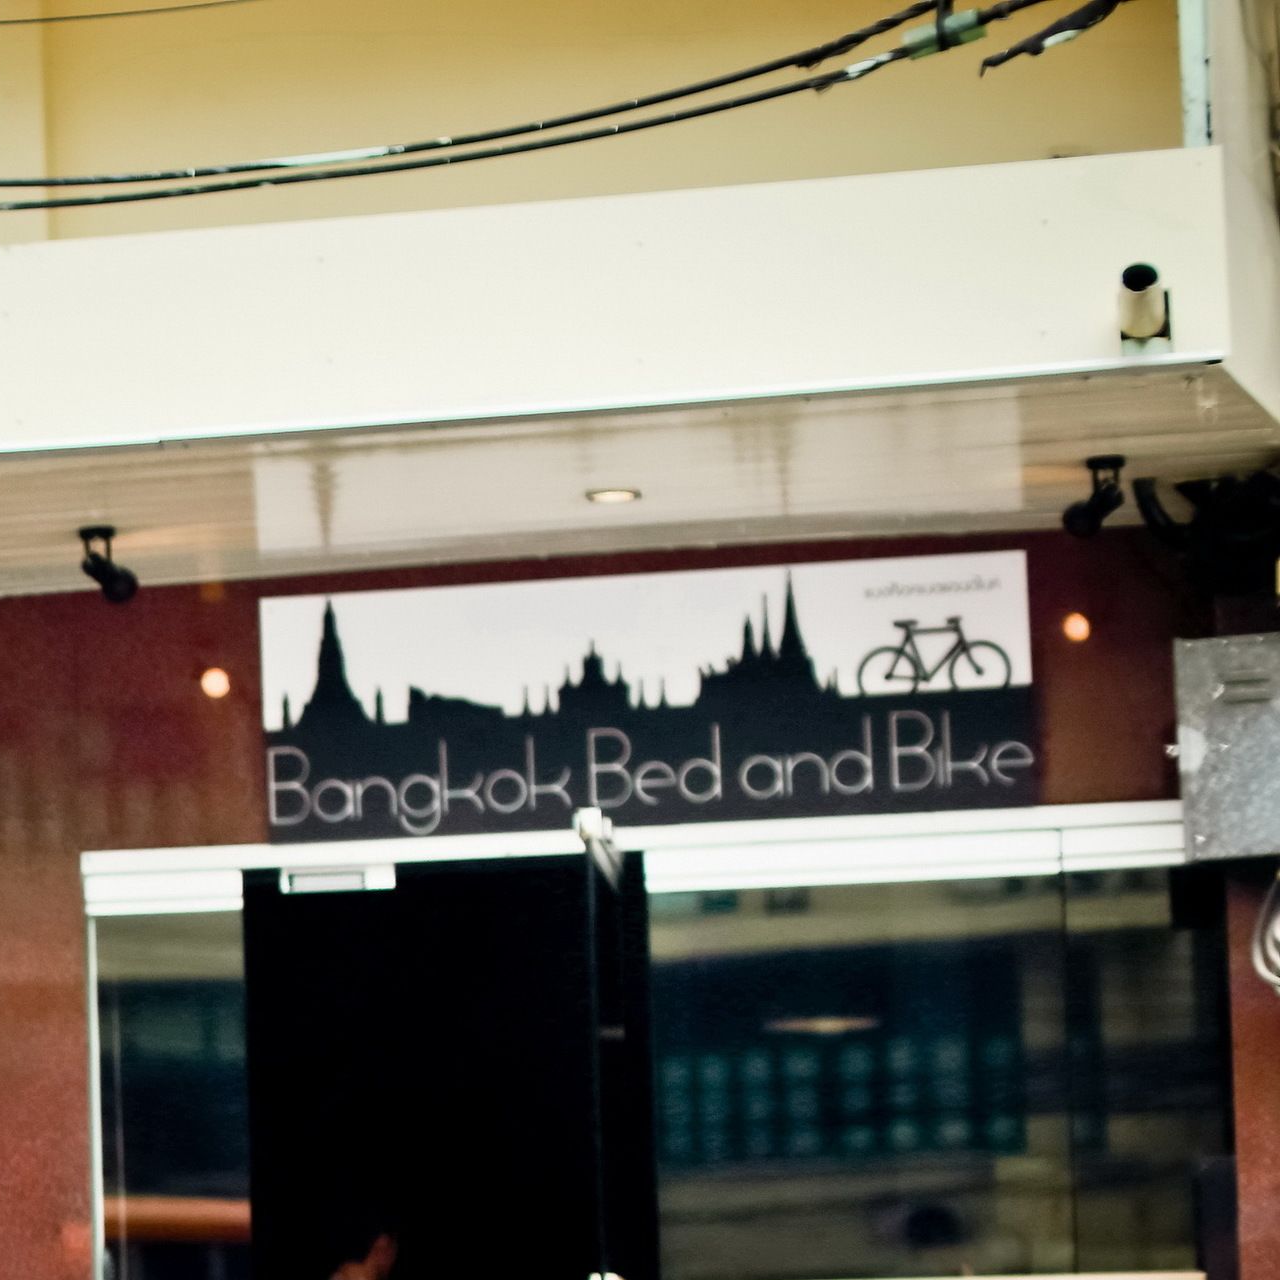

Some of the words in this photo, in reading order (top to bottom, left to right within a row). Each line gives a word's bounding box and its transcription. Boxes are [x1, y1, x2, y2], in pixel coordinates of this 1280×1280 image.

[266, 735, 572, 836] Bangkok
[586, 725, 723, 809] Bed
[739, 714, 873, 799] and
[889, 709, 1034, 793] Bike
